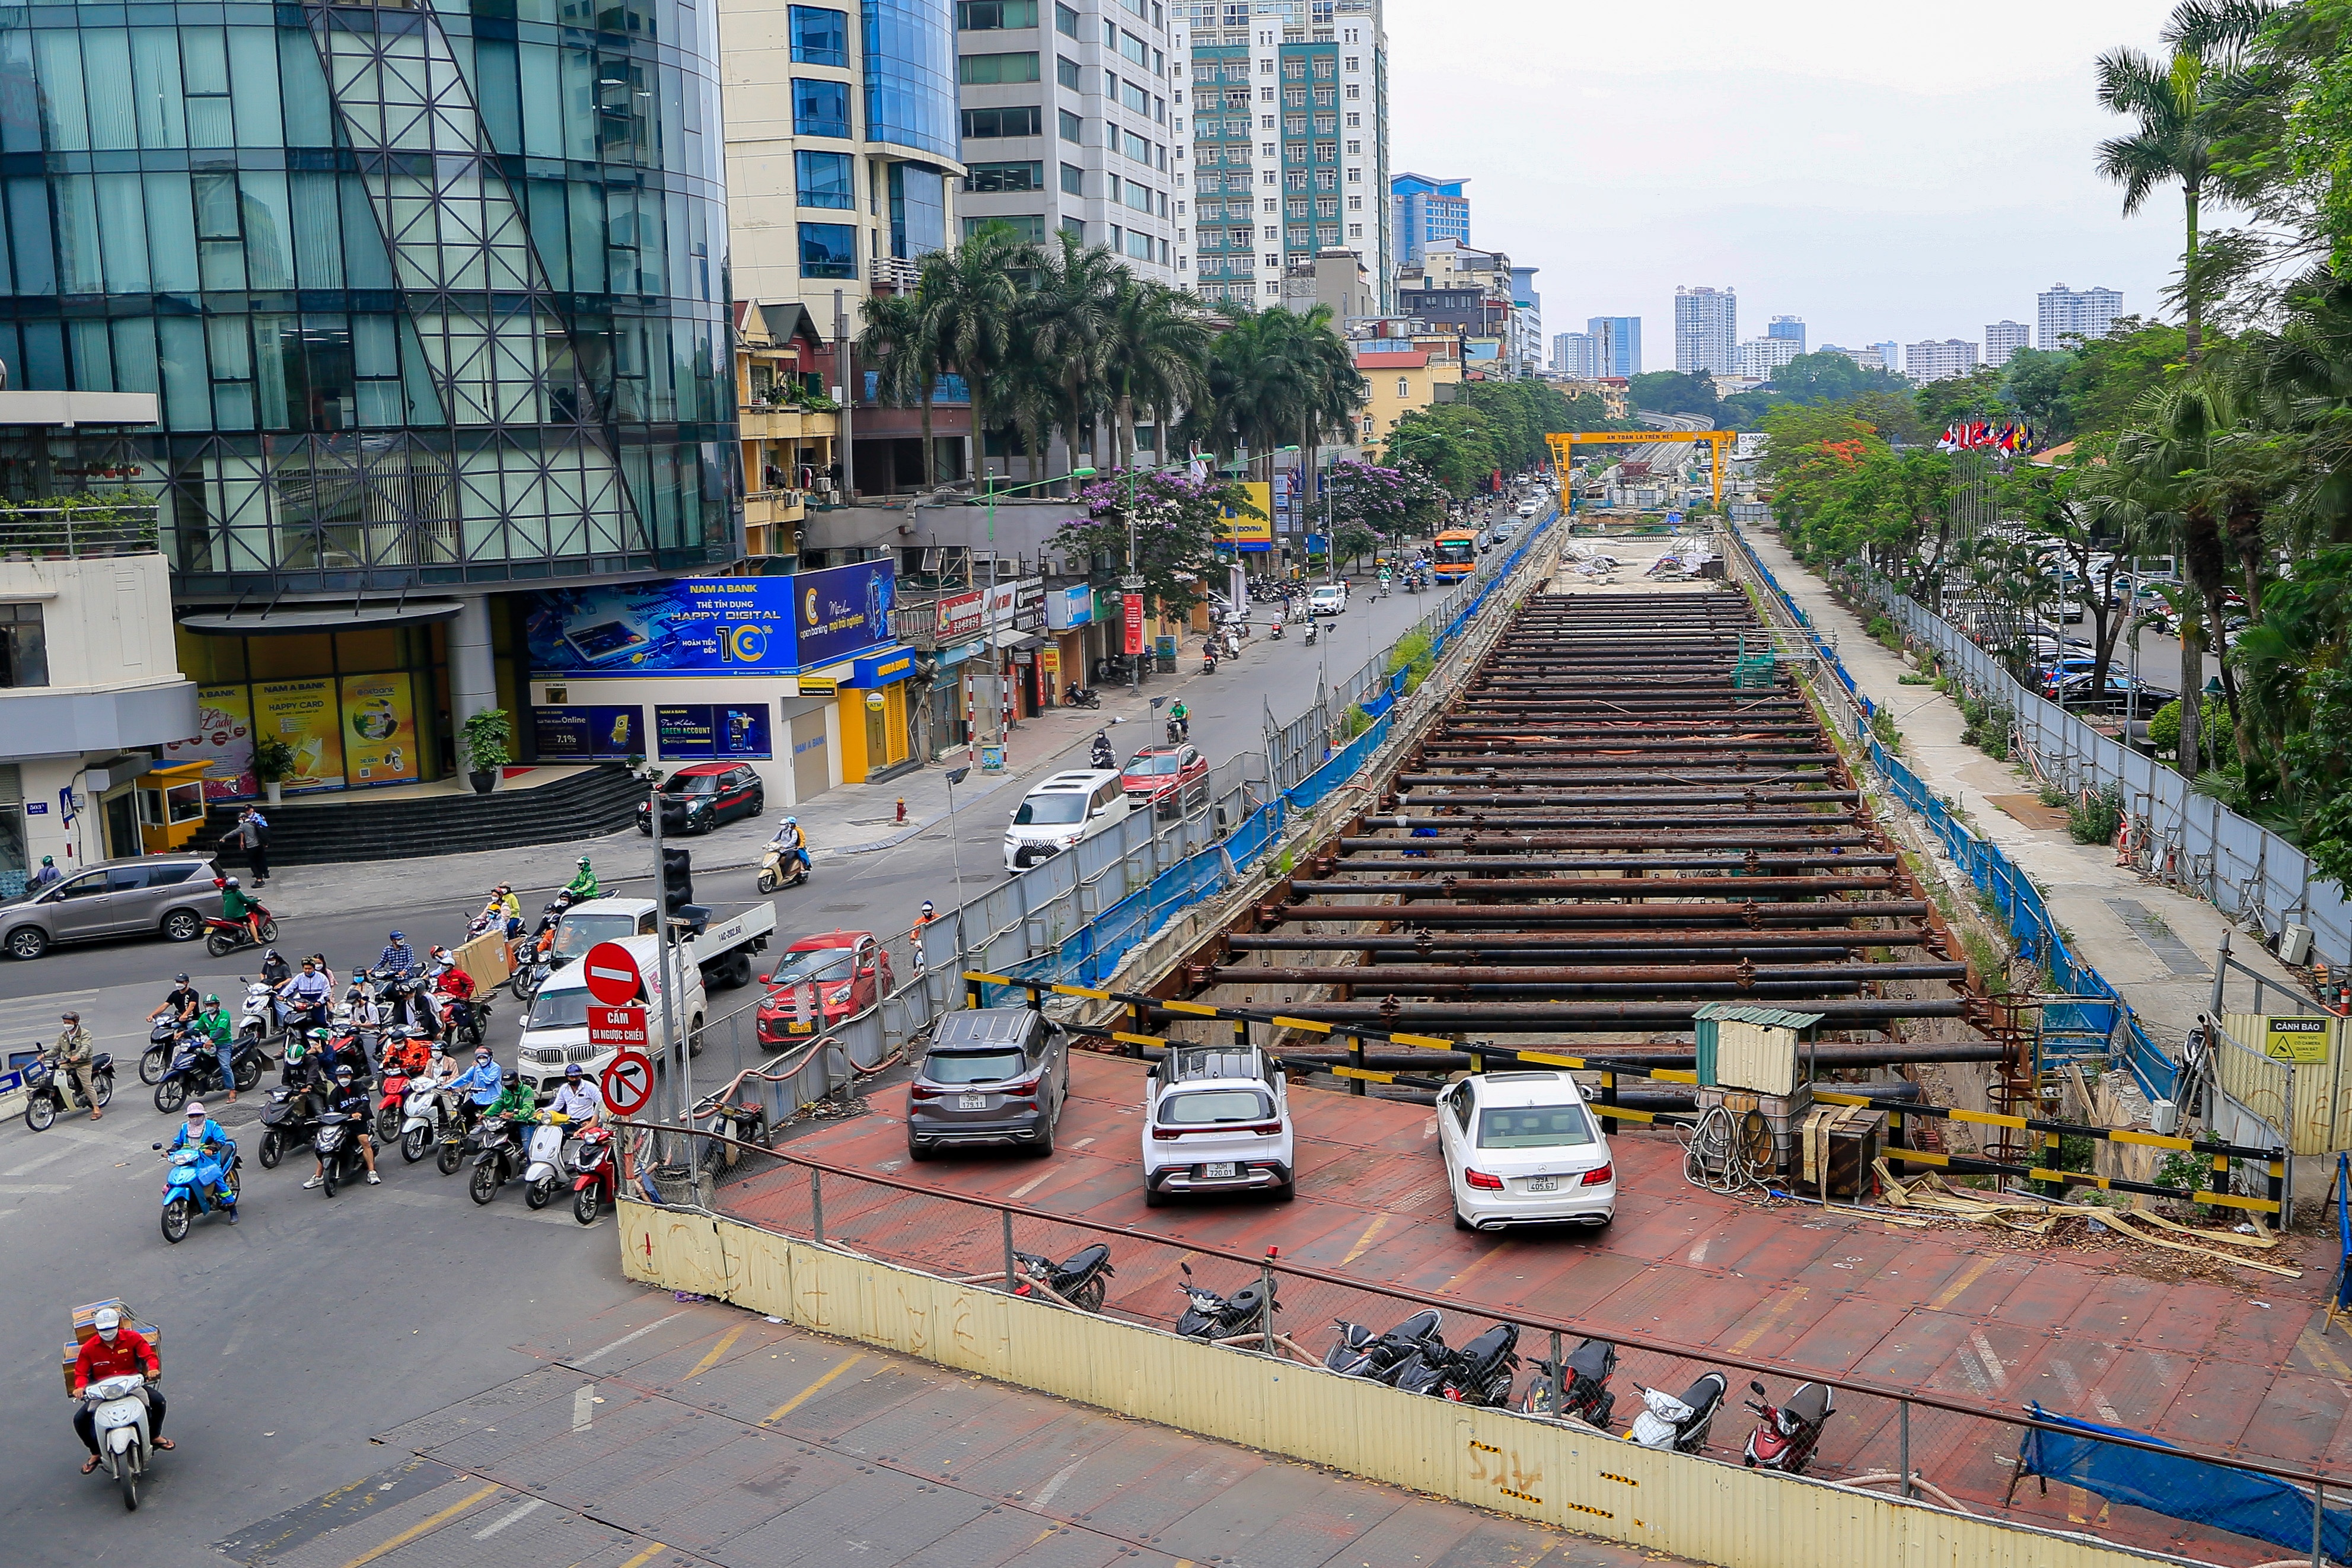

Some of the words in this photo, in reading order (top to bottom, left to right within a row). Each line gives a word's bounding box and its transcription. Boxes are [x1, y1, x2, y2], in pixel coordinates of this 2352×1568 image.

[690, 585, 715, 593] NAM
[726, 584, 758, 592] BANK
[714, 599, 728, 608] TÍN
[729, 601, 754, 610] DỤNG
[671, 611, 721, 620] HAPPY
[726, 610, 781, 620] DIGITAL
[811, 624, 828, 636] banking
[207, 690, 235, 698] BANK
[269, 702, 297, 711] HAPPY
[299, 700, 324, 709] CARD
[556, 735, 576, 743] 7.1%
[795, 742, 807, 754] NAM
[812, 735, 825, 748] BANK
[607, 1009, 629, 1025] CẤM
[2275, 1021, 2300, 1031] CẢNH
[2301, 1022, 2320, 1031] BÁO
[592, 1029, 600, 1039] ĐI
[600, 1029, 623, 1041] NGƯỢC
